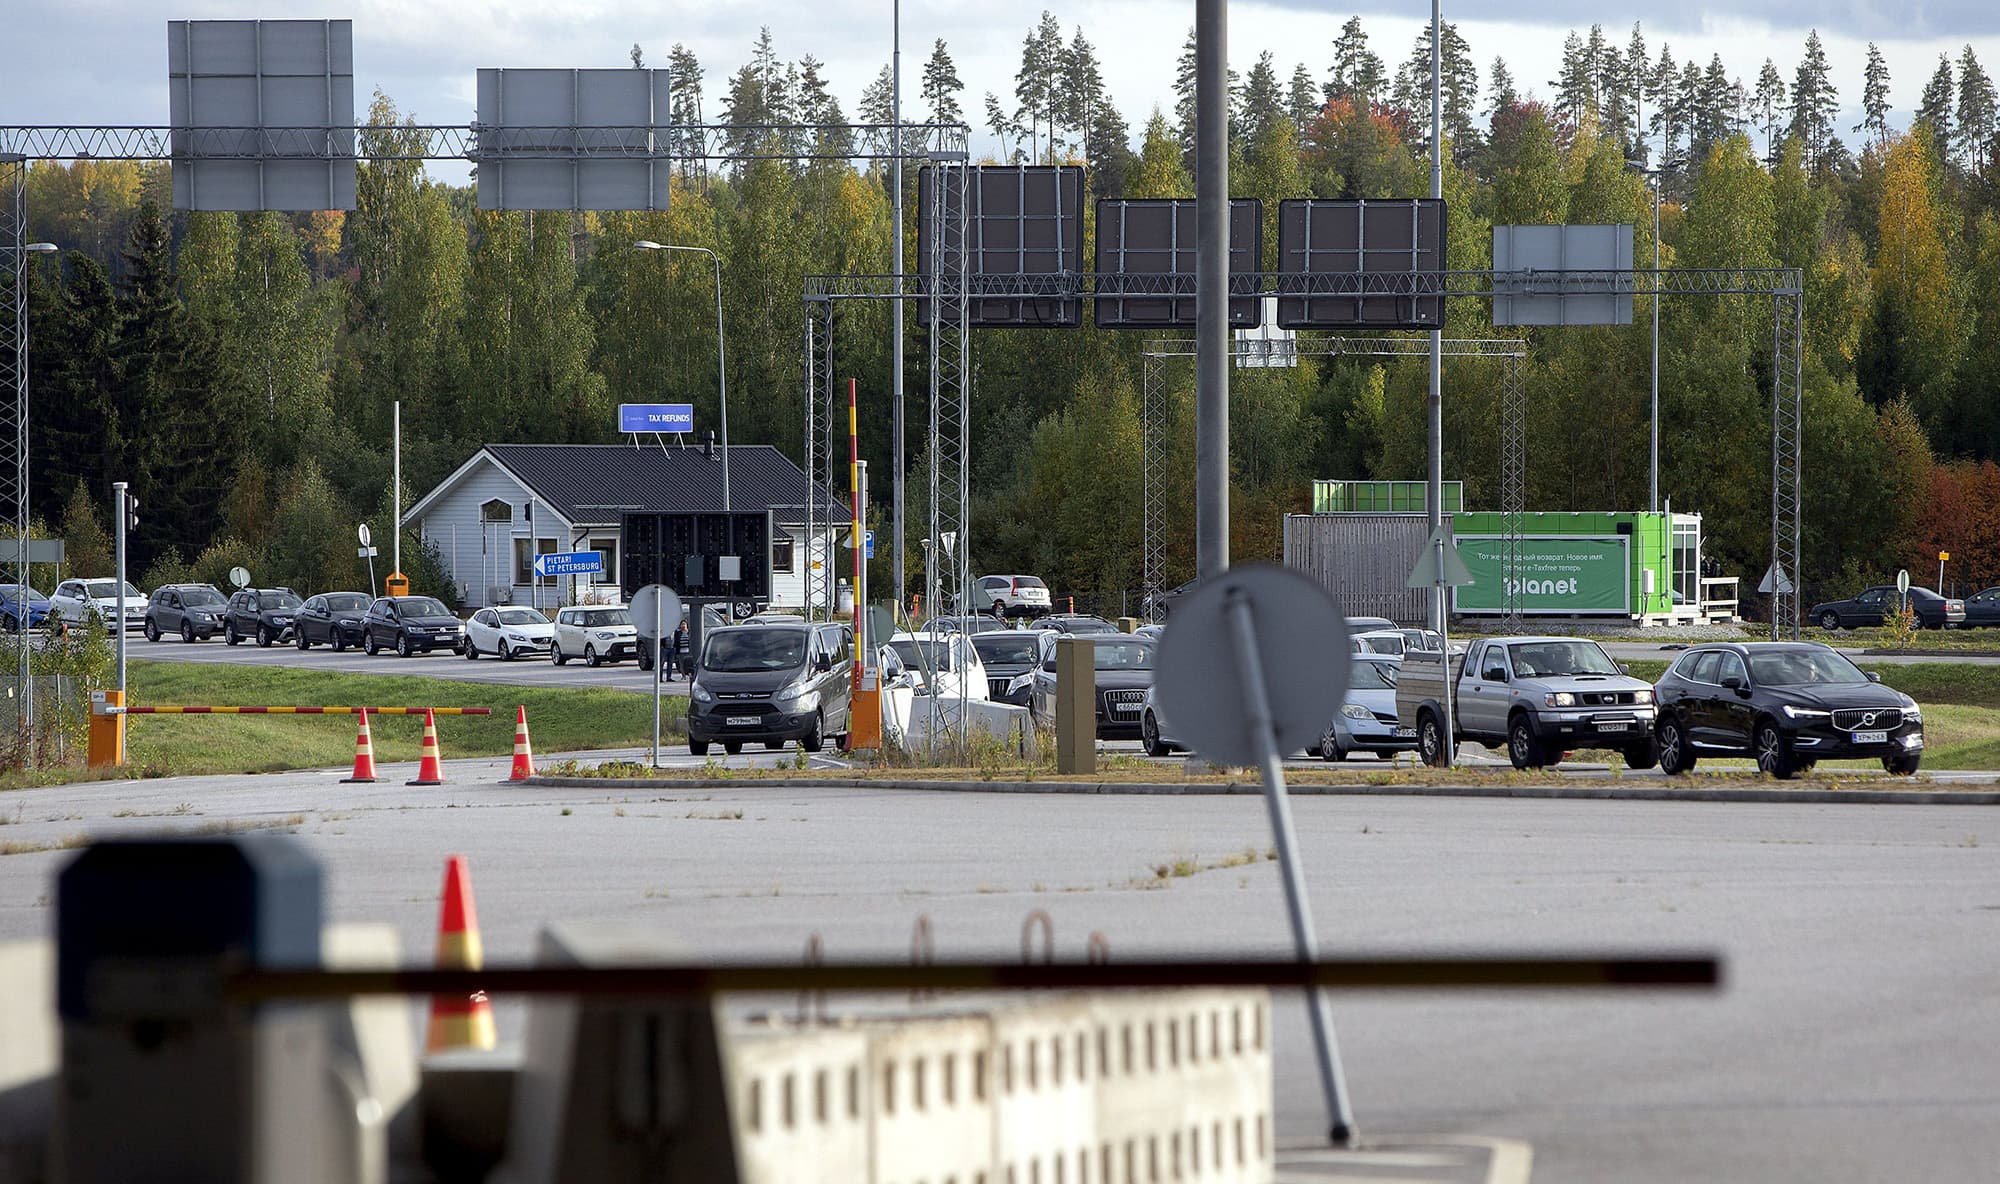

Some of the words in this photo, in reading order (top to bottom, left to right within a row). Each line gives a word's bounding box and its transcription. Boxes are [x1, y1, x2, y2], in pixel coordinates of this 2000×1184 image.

[648, 414, 661, 422] TAX
[662, 414, 690, 422] REFUNDS
[547, 556, 572, 565] PIETARI
[1566, 553, 1588, 561] Новое
[547, 564, 555, 573] ST
[557, 562, 599, 572] PETERSBURG
[1527, 563, 1557, 571] e-Taxfree
[1505, 577, 1577, 596] planet
